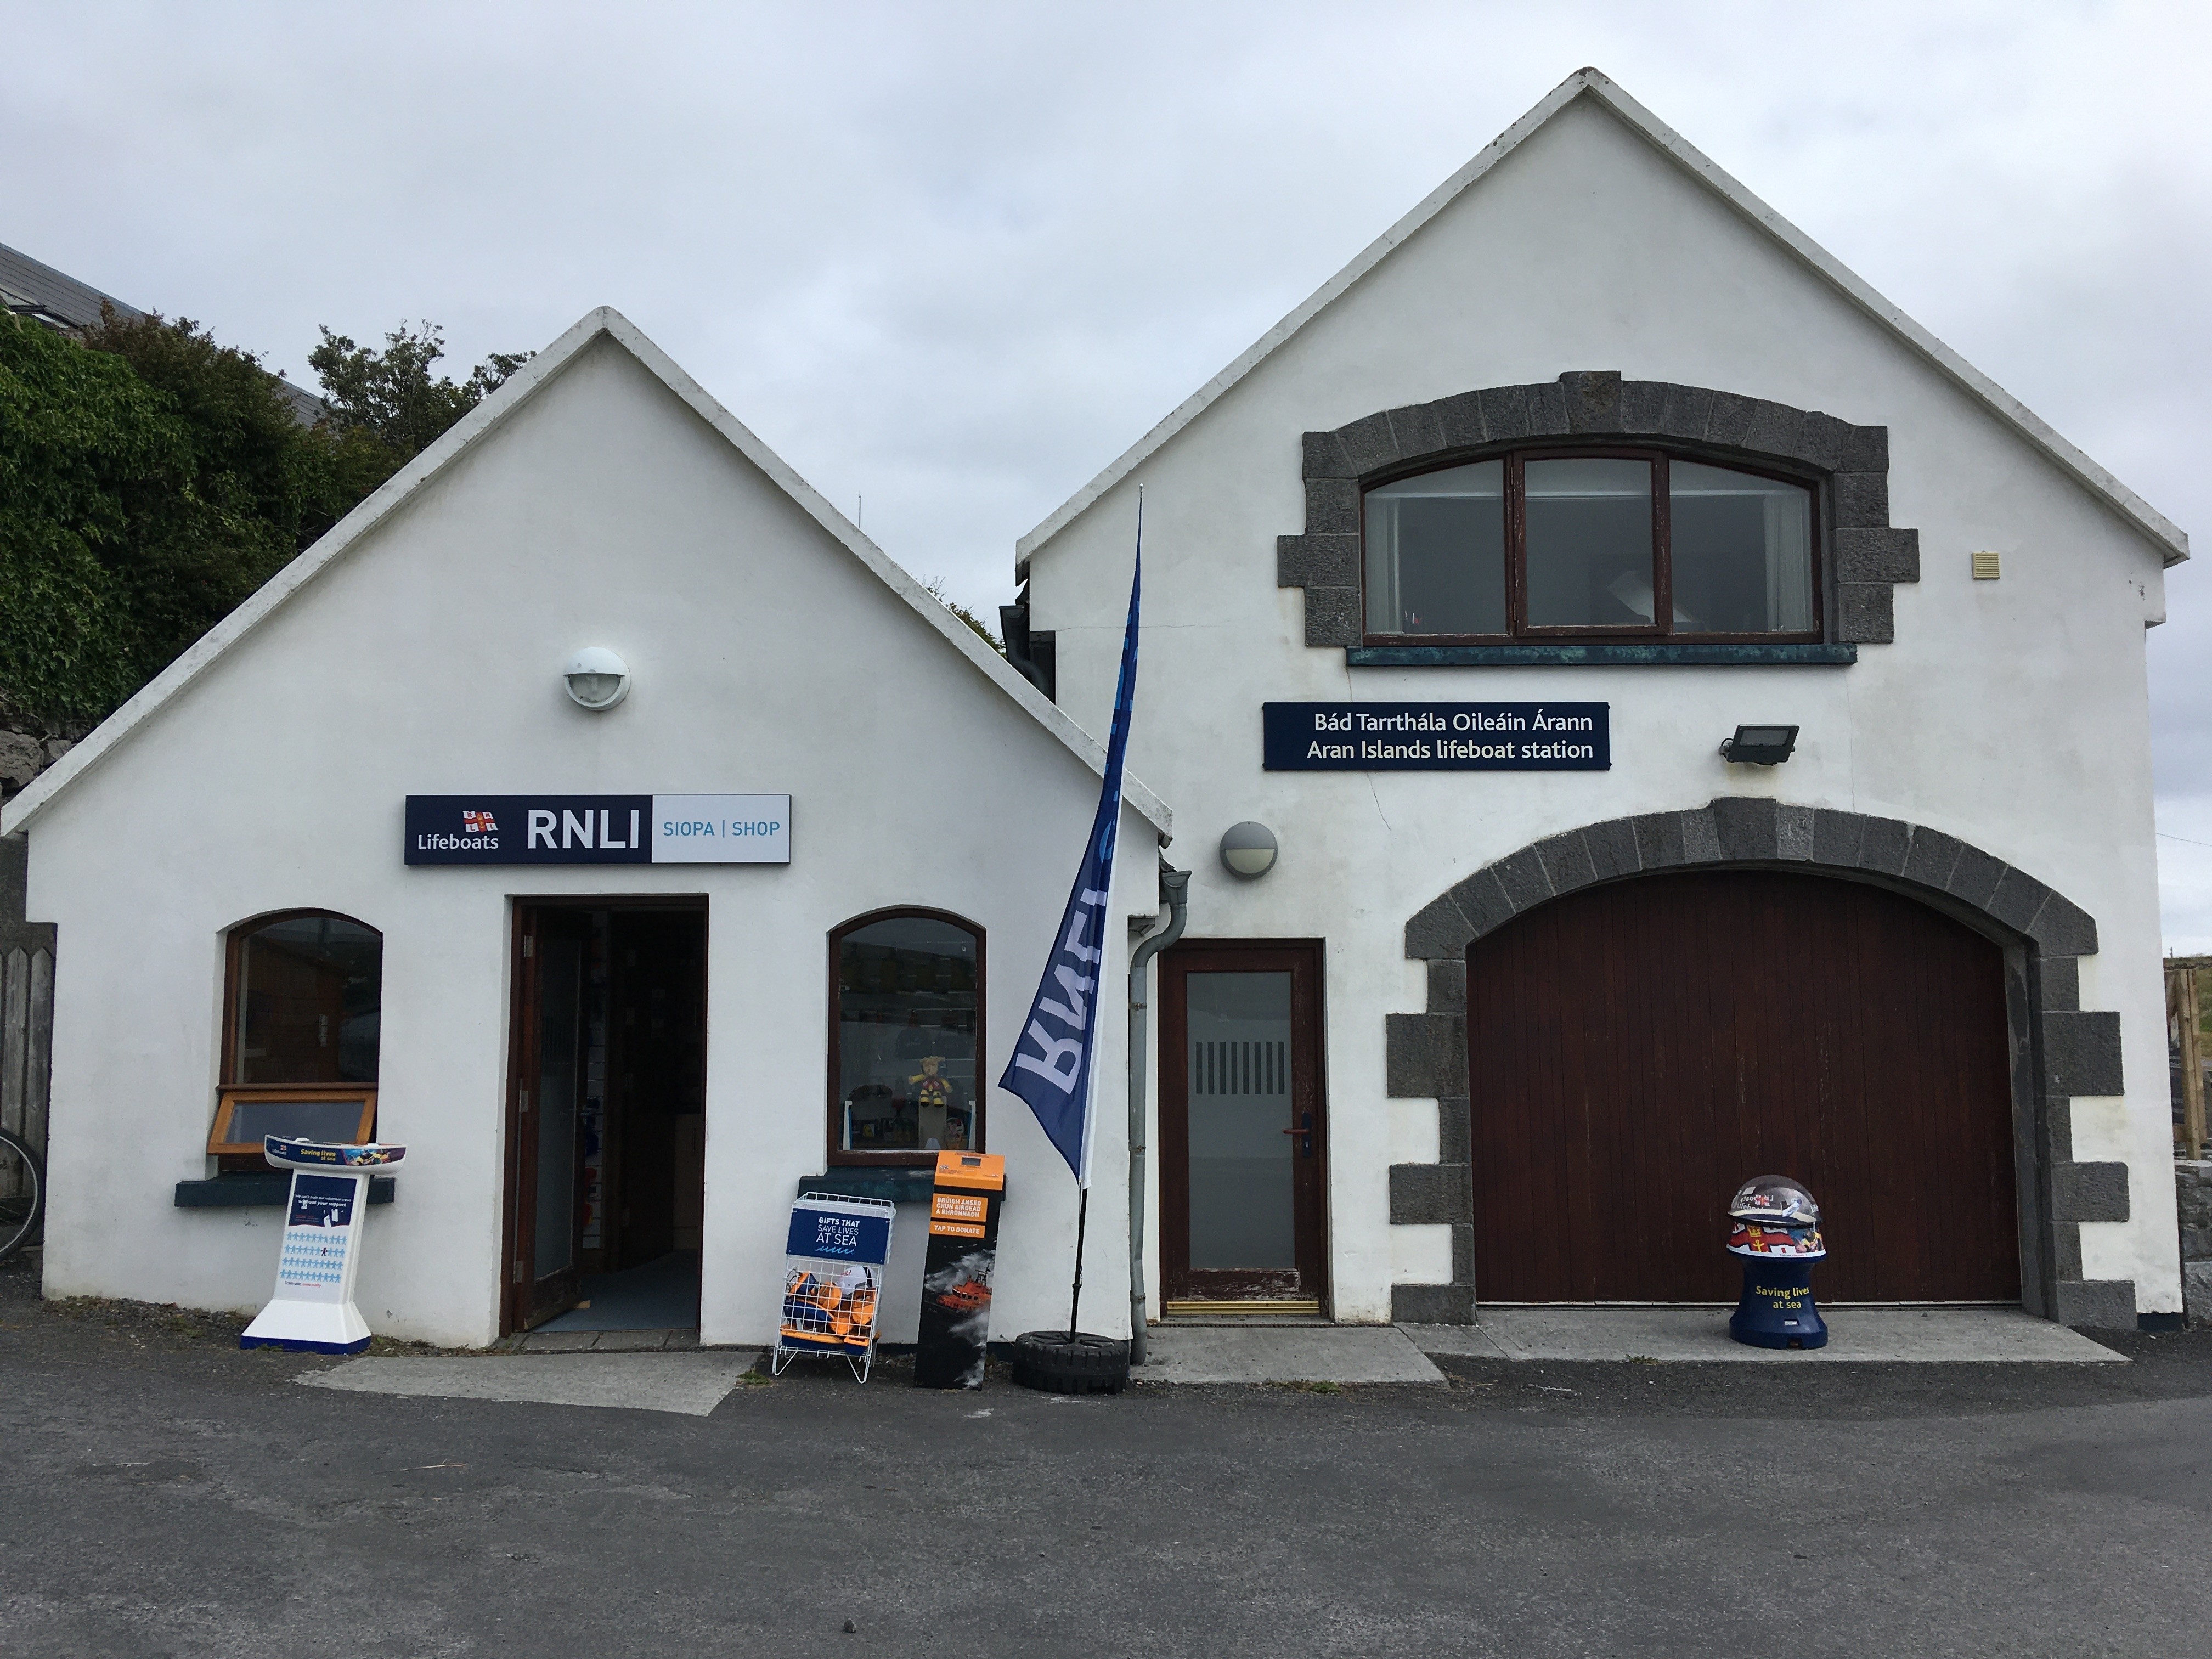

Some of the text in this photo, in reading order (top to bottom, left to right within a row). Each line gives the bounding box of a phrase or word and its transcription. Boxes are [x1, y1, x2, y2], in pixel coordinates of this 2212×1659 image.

[1314, 708, 1593, 731] Bád Tarrthála Oileáin Árann
[1307, 740, 1593, 759] Aran Islands lifeboat station
[527, 809, 640, 849] RNLI
[663, 821, 780, 837] SIOPA SHOP
[417, 833, 499, 849] Lifeboats
[300, 1149, 320, 1157] Saving
[937, 1196, 960, 1204] BRÚIGH
[941, 1209, 979, 1217] BHRONNADH
[819, 1217, 860, 1227] GIFTS THAT
[817, 1224, 859, 1235] SAVE LIVES
[816, 1233, 857, 1246] AT SEA
[1756, 1285, 1810, 1300] Saving lives
[1773, 1300, 1784, 1308] at
